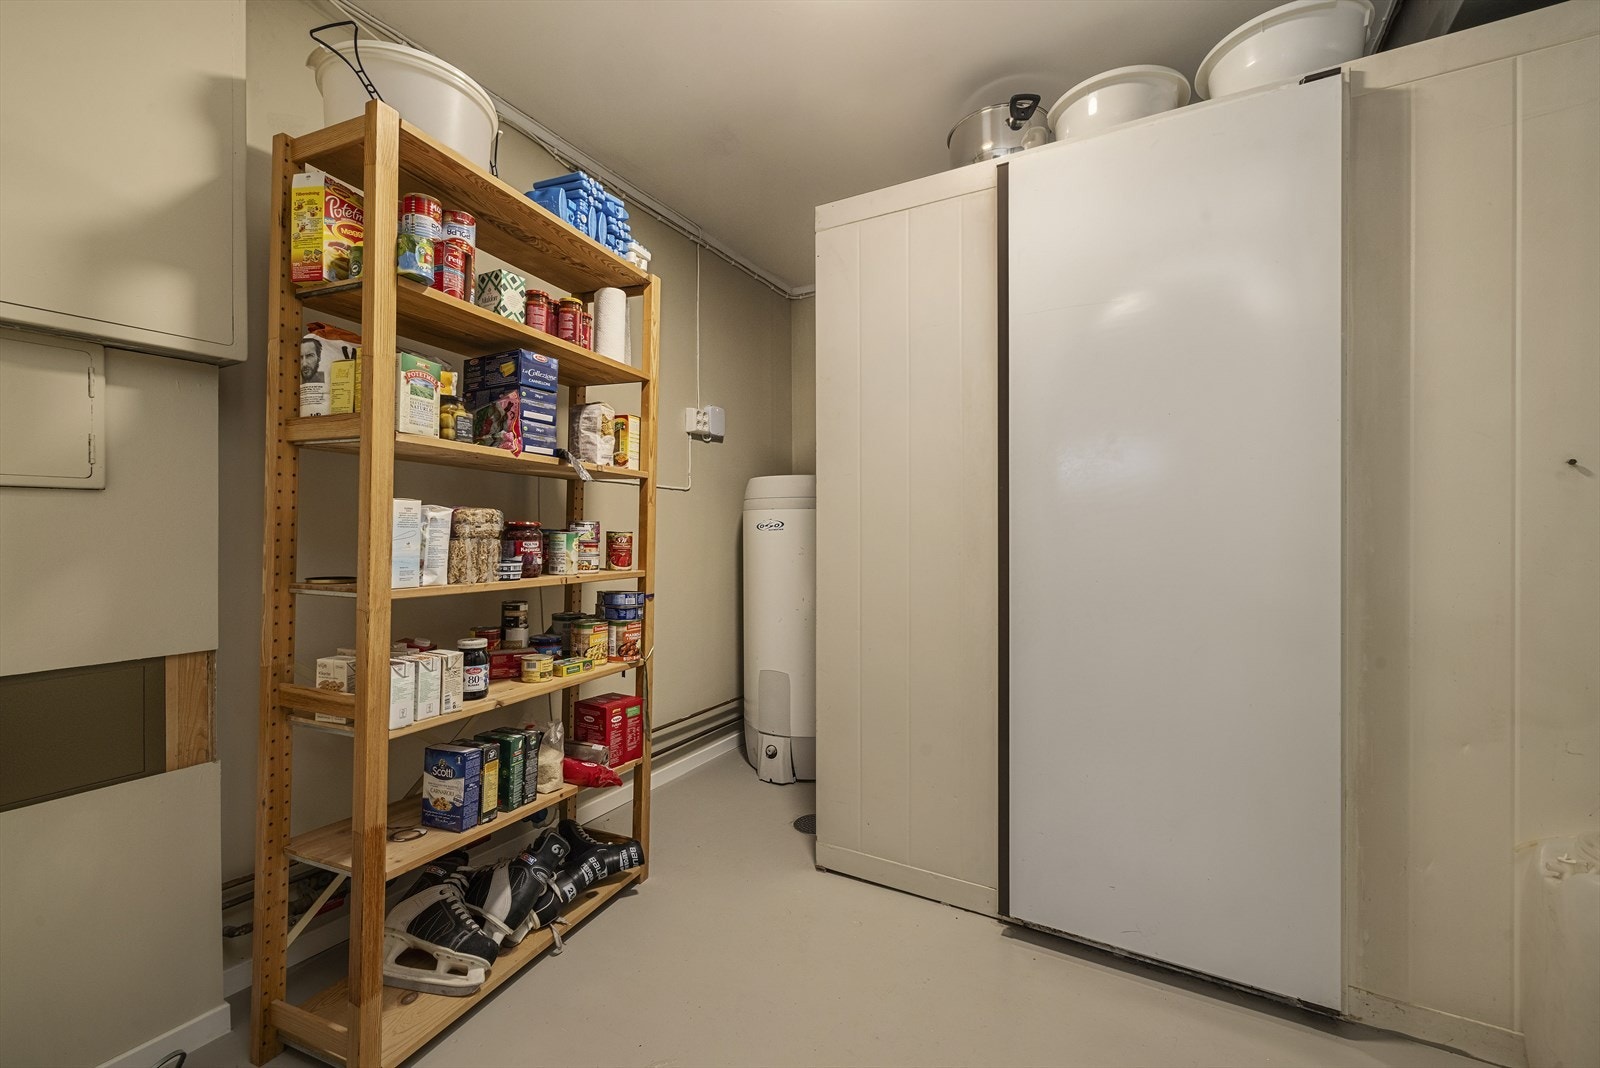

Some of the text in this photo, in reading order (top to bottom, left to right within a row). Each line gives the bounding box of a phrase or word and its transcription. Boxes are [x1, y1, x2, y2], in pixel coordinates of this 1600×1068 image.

[325, 195, 364, 221] Potetm
[340, 227, 364, 239] Magg
[467, 675, 480, 684] 80
[432, 766, 454, 779] Scotti
